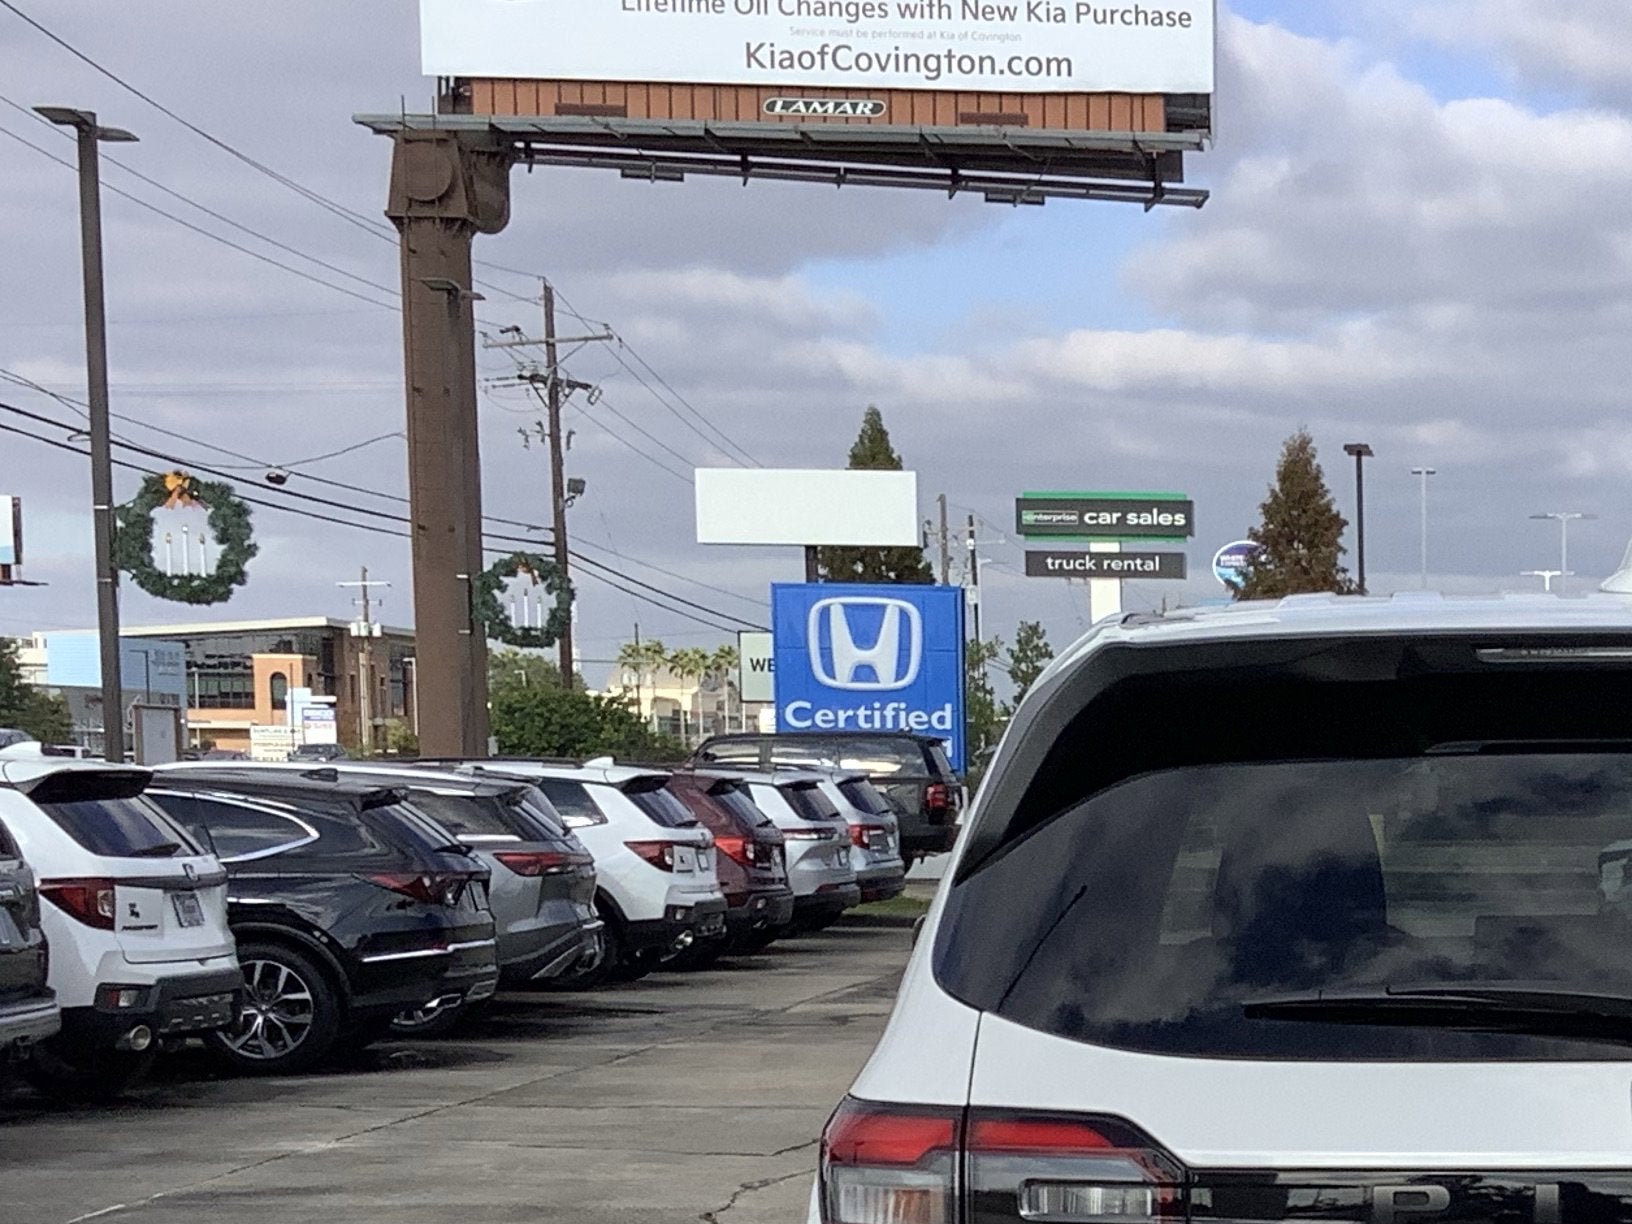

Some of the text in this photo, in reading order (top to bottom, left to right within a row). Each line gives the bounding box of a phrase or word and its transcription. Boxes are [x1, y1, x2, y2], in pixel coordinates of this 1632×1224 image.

[778, 0, 889, 23] Changes
[897, 0, 952, 20] with
[961, 1, 1018, 22] New
[1026, 1, 1066, 23] Kia
[1076, 2, 1192, 28] Purchase
[790, 26, 1022, 43] Service must be performed at Kia of Covington
[745, 41, 1073, 80] KiaofCovington.com
[773, 100, 874, 115] LAMAR
[1083, 511, 1122, 525] car
[1126, 508, 1186, 525] sales
[1046, 555, 1160, 571] truck rental
[785, 700, 953, 730] Certified
